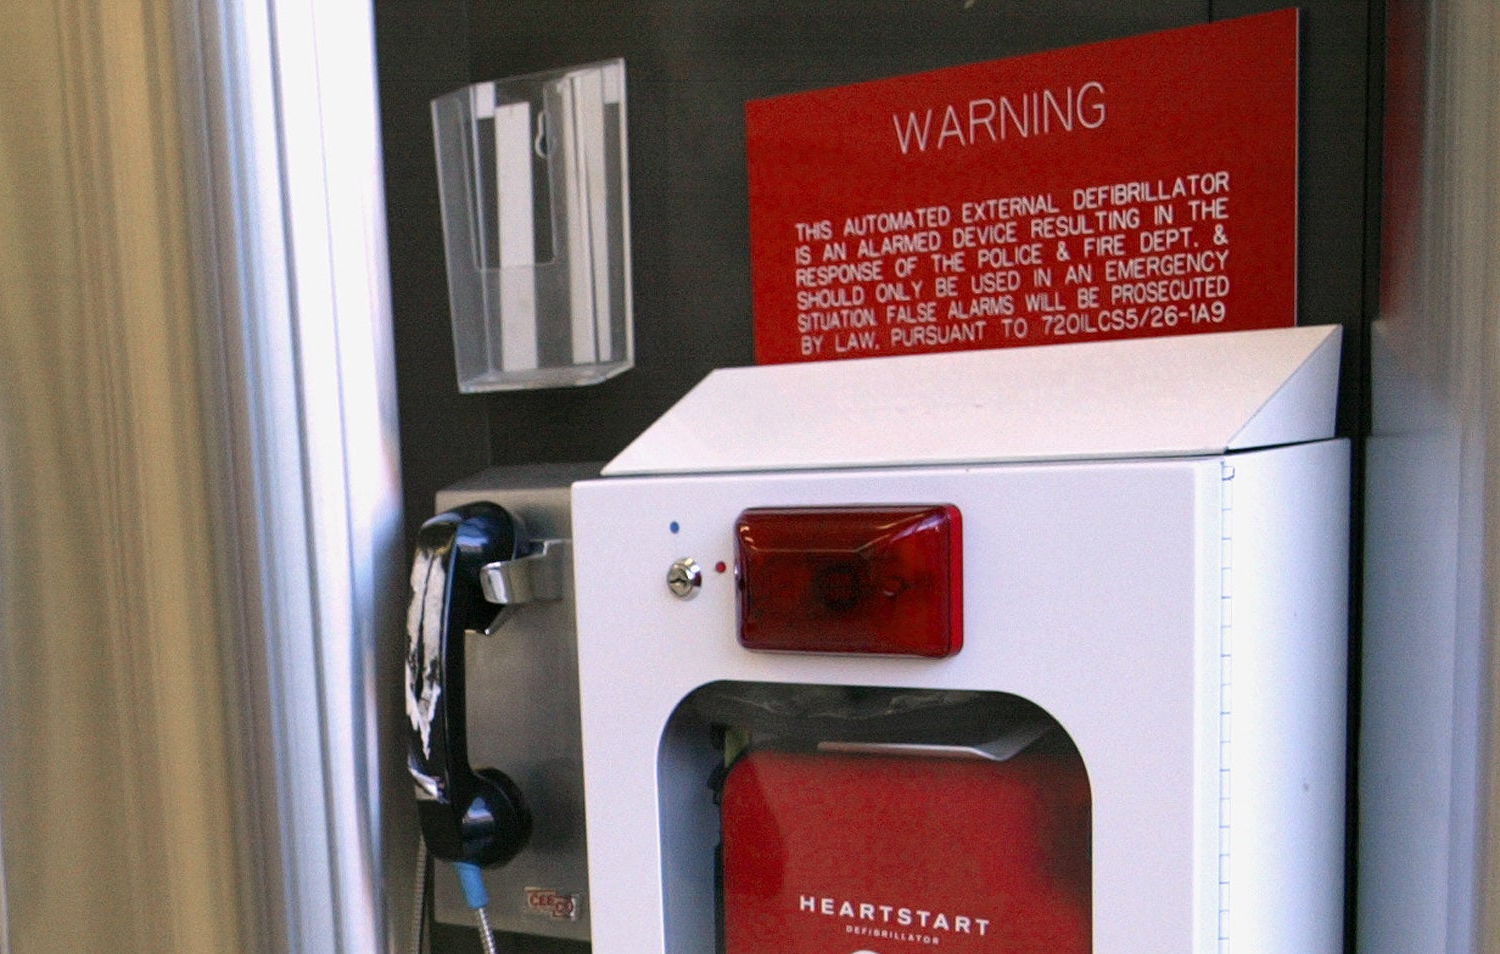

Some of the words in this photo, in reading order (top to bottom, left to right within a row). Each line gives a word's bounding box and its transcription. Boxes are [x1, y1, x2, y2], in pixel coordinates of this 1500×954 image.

[893, 81, 1105, 154] WARNING
[795, 220, 832, 242] THIS
[843, 205, 951, 237] AUTOMATED
[962, 194, 1060, 223] EXTERNAL
[1073, 171, 1229, 210] DEFIBRILLATOR
[795, 245, 811, 265] IS
[823, 242, 847, 261] AN
[857, 231, 941, 258] ALARMED
[953, 222, 1017, 248] DEVICE
[1031, 208, 1140, 238] RESULTING
[1154, 204, 1173, 225] IN
[1188, 197, 1229, 222] THE
[796, 260, 883, 287] RESPONSE
[895, 256, 918, 278] OF
[931, 252, 965, 273] THE
[978, 243, 1042, 268] POLICE
[1056, 241, 1071, 261] &
[1084, 234, 1126, 258] FIRE
[1140, 227, 1199, 253] DEPT.
[1213, 224, 1229, 245] &
[797, 286, 865, 310] SHOULD
[875, 280, 923, 303] ONLY
[935, 276, 958, 297] BE
[971, 270, 1021, 294] USED
[1034, 268, 1051, 288] IN
[1065, 264, 1092, 285] AN
[1105, 250, 1229, 282] EMERGENCY
[887, 302, 937, 324] FALSE
[948, 295, 1014, 319] ALARMS
[1025, 292, 1066, 312] WILL
[1077, 287, 1099, 308] BE
[1111, 275, 1230, 305] PROSECUTED
[801, 335, 823, 355] BY
[891, 320, 986, 347] PURSUANT
[1002, 318, 1028, 338] TO
[800, 895, 989, 936] HEARTSTART
[846, 925, 939, 945] DEFIBRILLATOR
